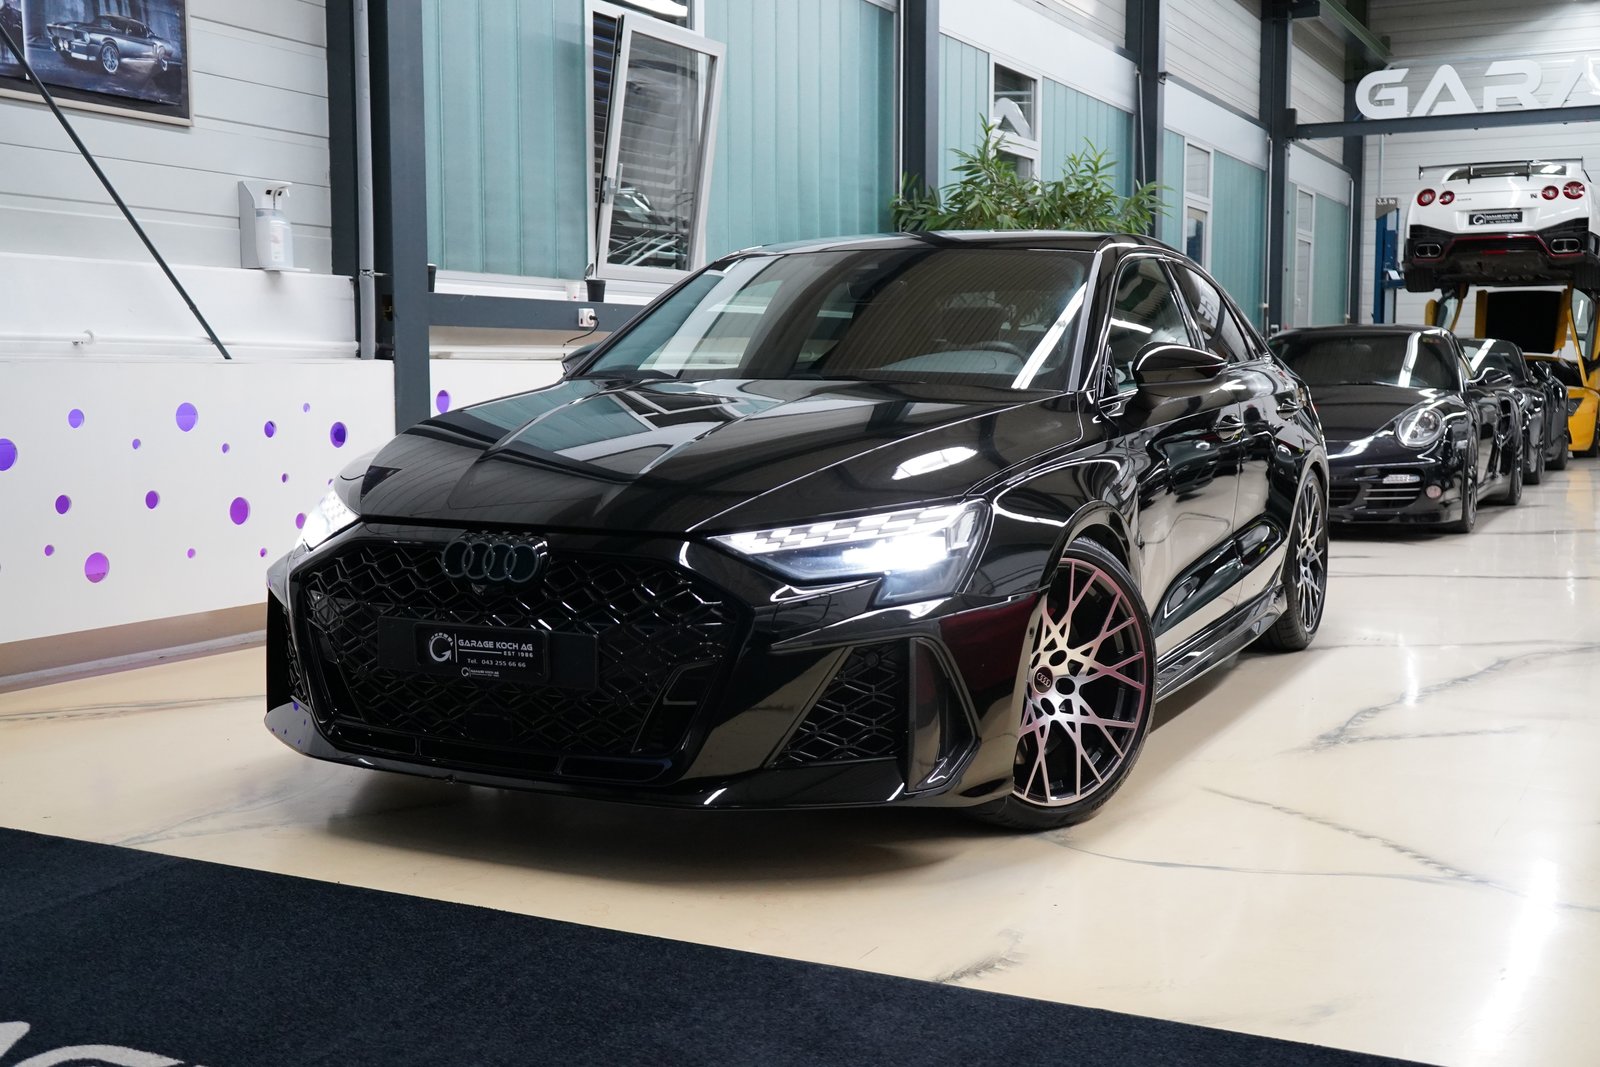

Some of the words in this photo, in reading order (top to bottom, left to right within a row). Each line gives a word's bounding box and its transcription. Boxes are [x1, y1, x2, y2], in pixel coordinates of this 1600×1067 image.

[458, 639, 494, 649] GARAGE
[495, 641, 519, 650] KOCH
[520, 643, 533, 651] AG
